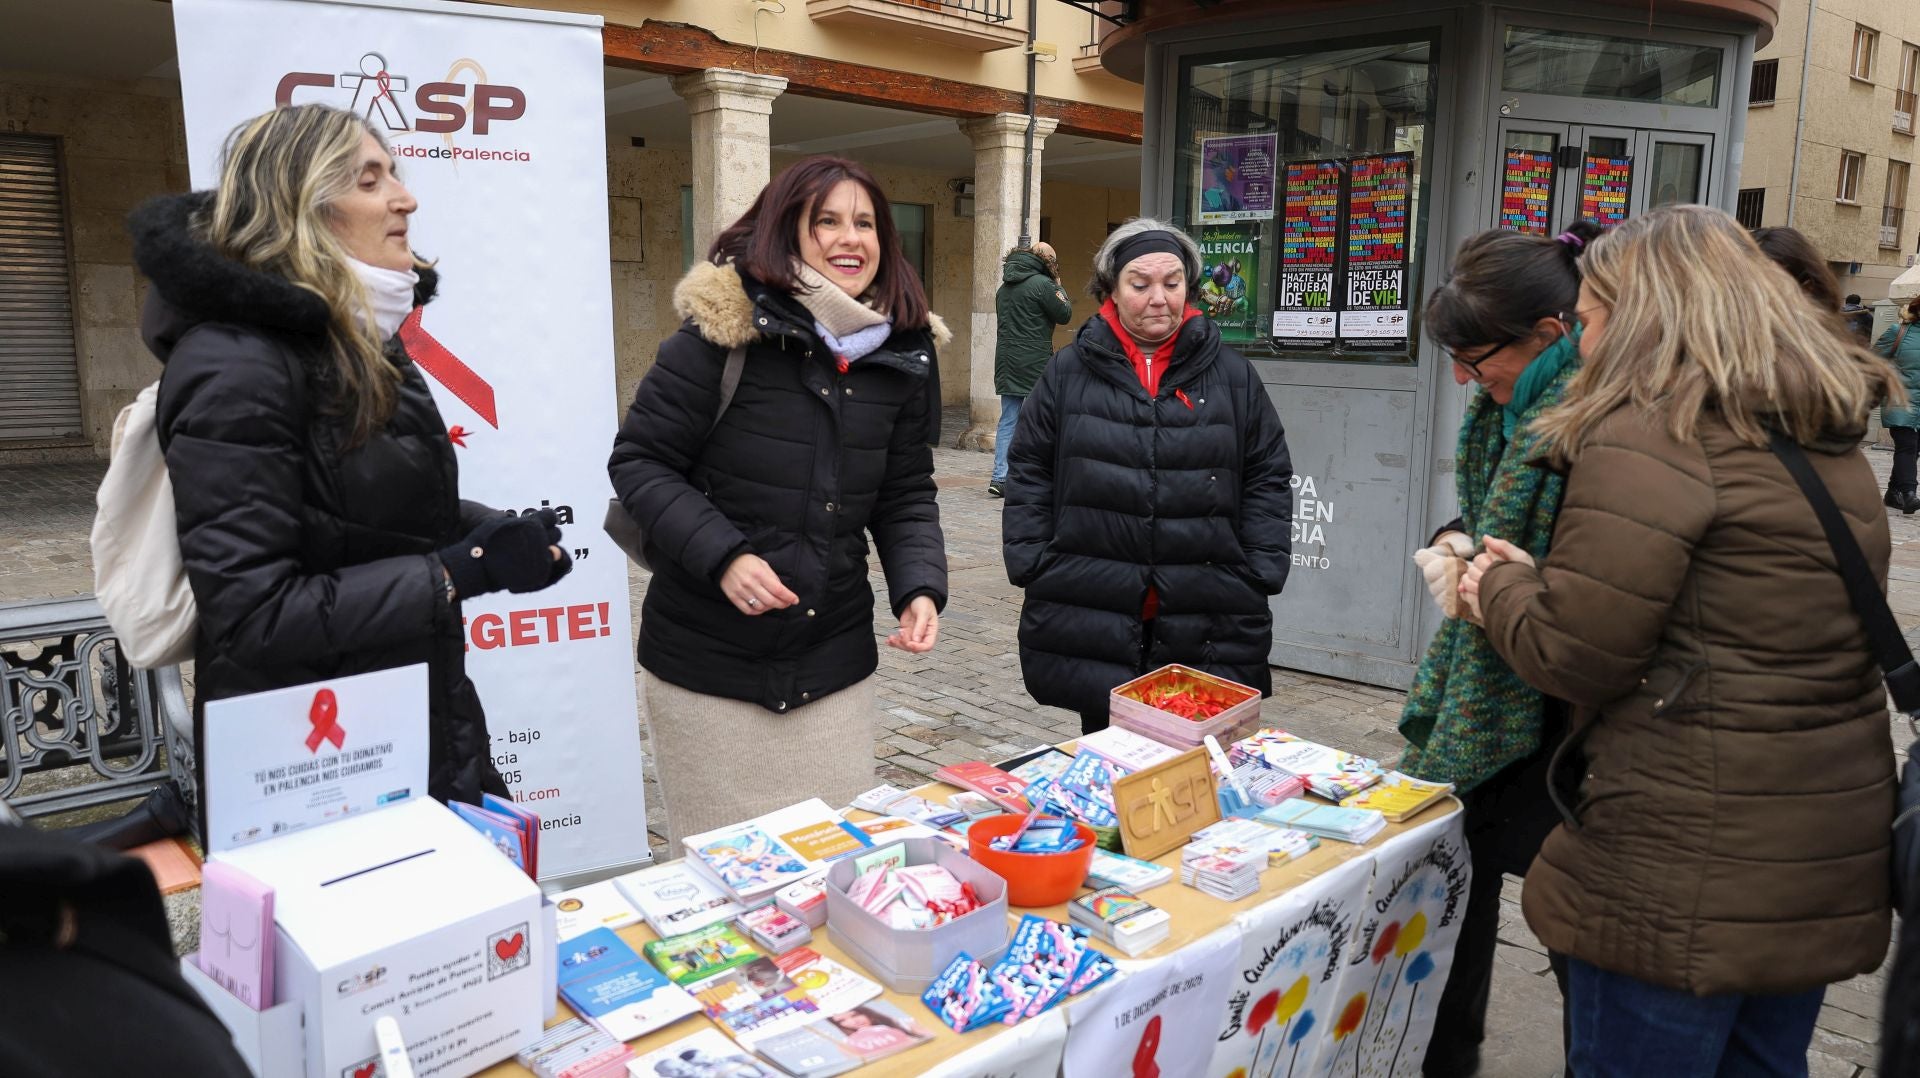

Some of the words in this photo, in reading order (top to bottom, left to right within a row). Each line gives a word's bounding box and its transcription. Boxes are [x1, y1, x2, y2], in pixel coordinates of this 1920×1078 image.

[1200, 242, 1254, 254] ALENCIA
[1317, 273, 1327, 281] LA
[1386, 270, 1397, 279] LA
[1287, 282, 1327, 292] PRUEBA
[1353, 280, 1397, 290] PRUEBA
[1286, 293, 1302, 306] DE
[1353, 291, 1370, 305] DE
[1292, 498, 1334, 522] EN
[462, 602, 610, 652] GETE!
[509, 728, 541, 744] bajo
[268, 768, 286, 780] NOS
[288, 759, 319, 776] CUIDAS
[321, 756, 339, 769] CON
[353, 742, 394, 761] DONATIVO
[264, 784, 276, 796] EN
[278, 774, 320, 792] PALENCIA
[322, 770, 339, 782] NOS
[340, 758, 383, 777] CUIDAMOS
[409, 967, 440, 983] Puedes
[1121, 1009, 1131, 1027] DE
[1133, 985, 1169, 1020] DICIEMBRE
[1169, 981, 1182, 996] DE
